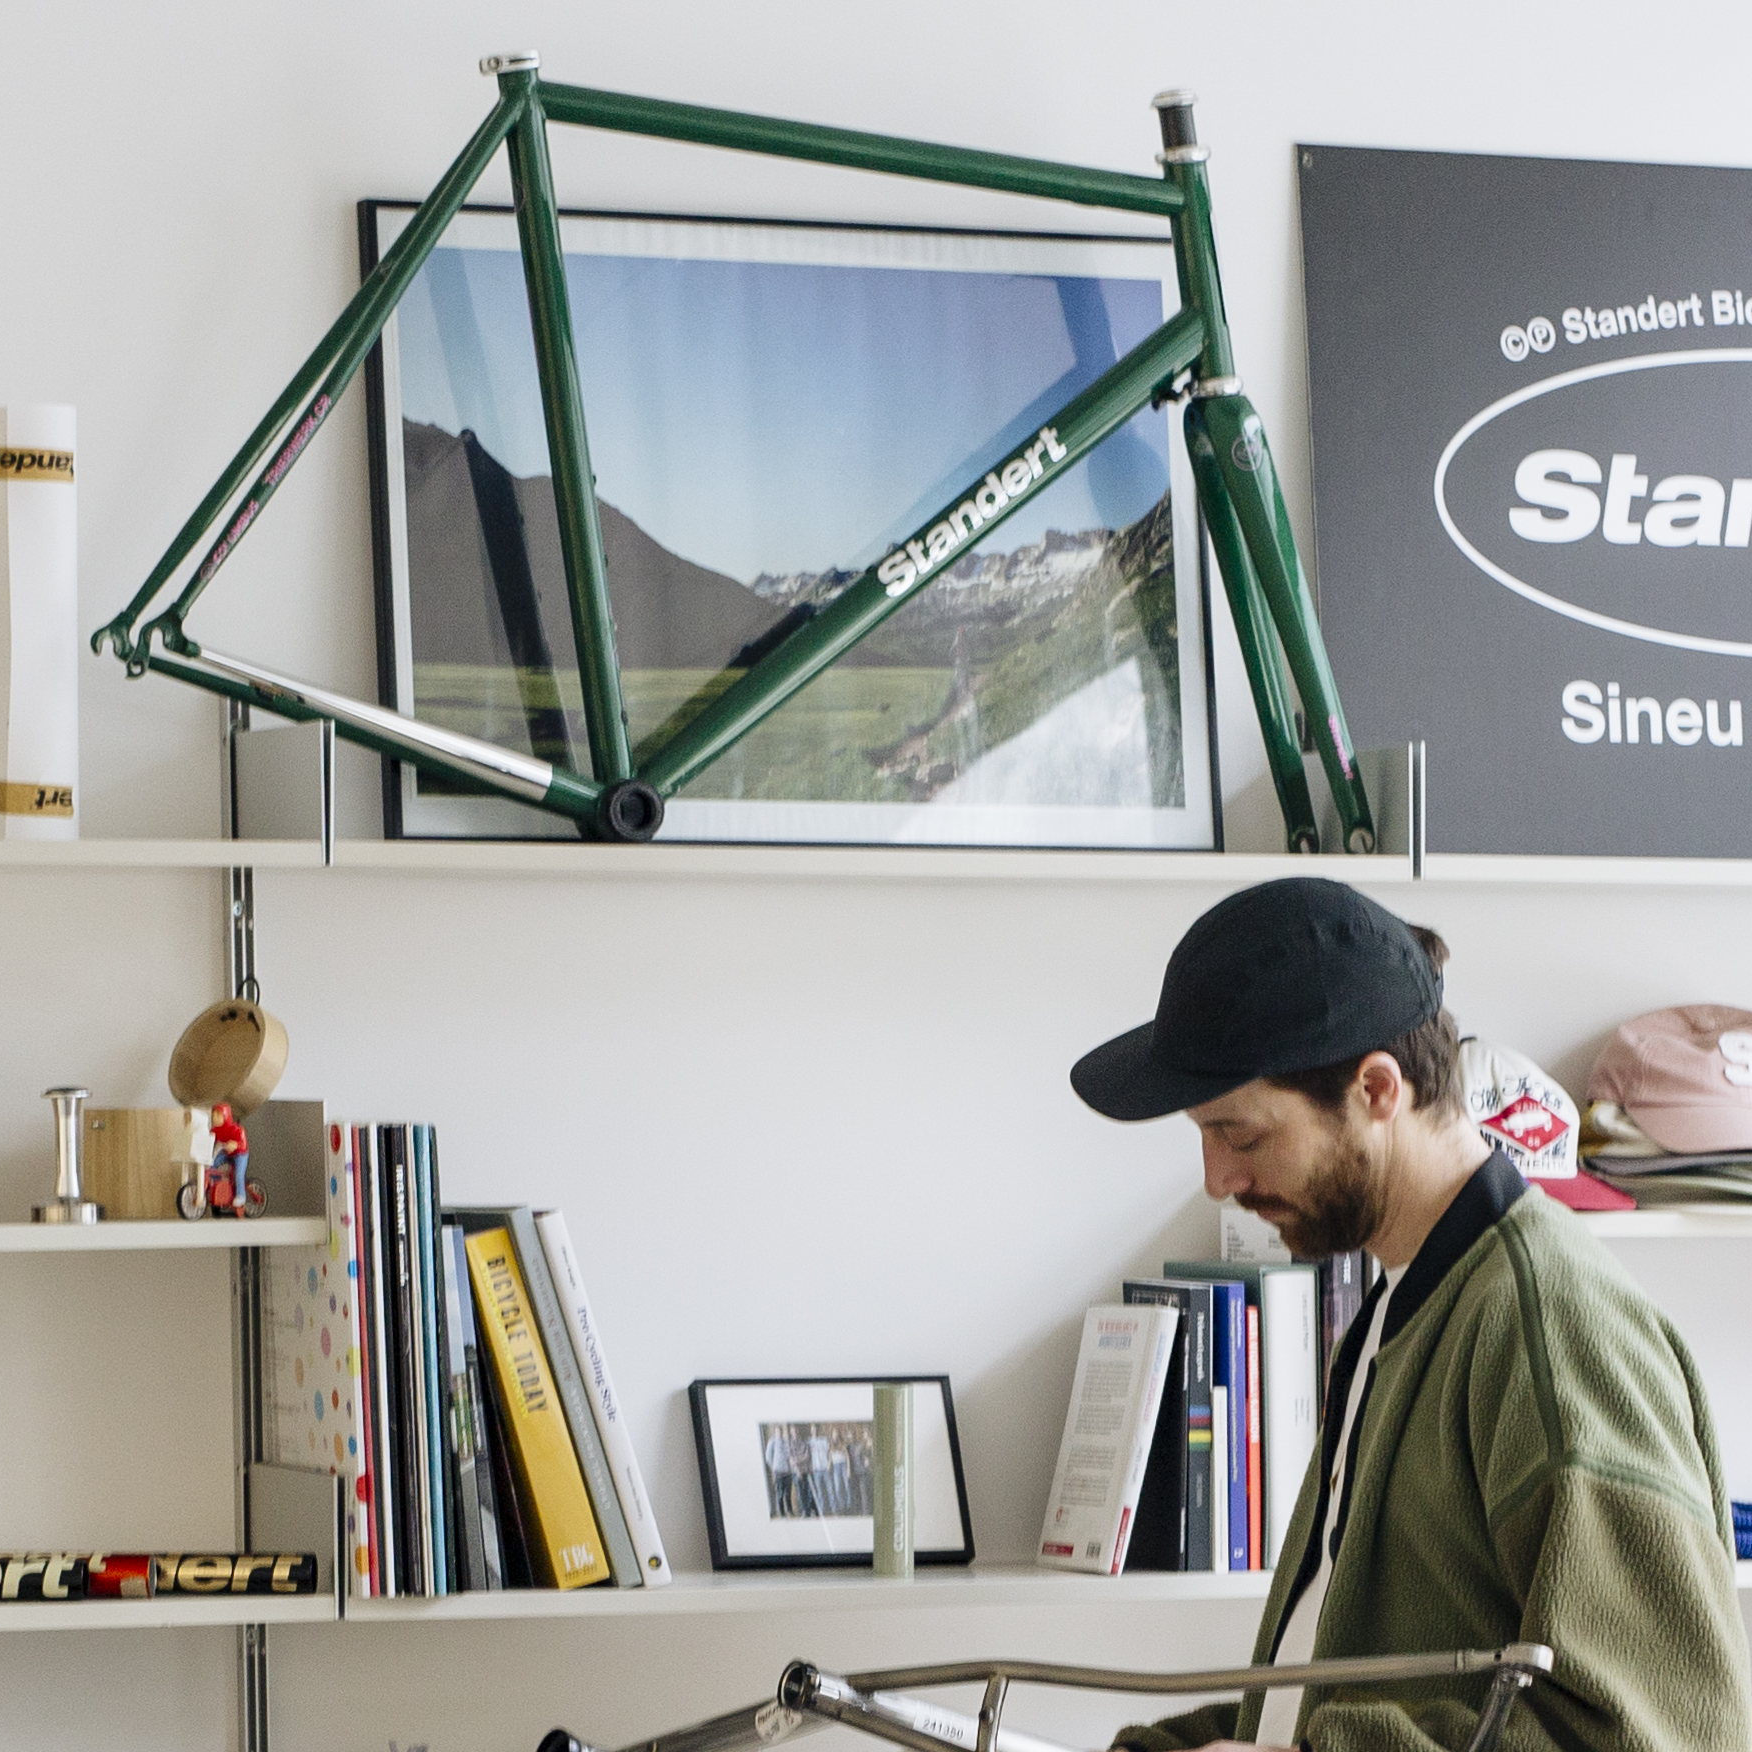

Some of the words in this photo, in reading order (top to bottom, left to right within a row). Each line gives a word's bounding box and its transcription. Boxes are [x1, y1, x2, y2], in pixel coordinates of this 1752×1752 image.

[1562, 293, 1704, 344] Standert
[877, 426, 1067, 598] Standert
[1561, 680, 1744, 747] Sineu
[487, 1255, 528, 1344] BICYCLE
[514, 1350, 549, 1414] TODAY
[585, 1332, 606, 1388] Cycling
